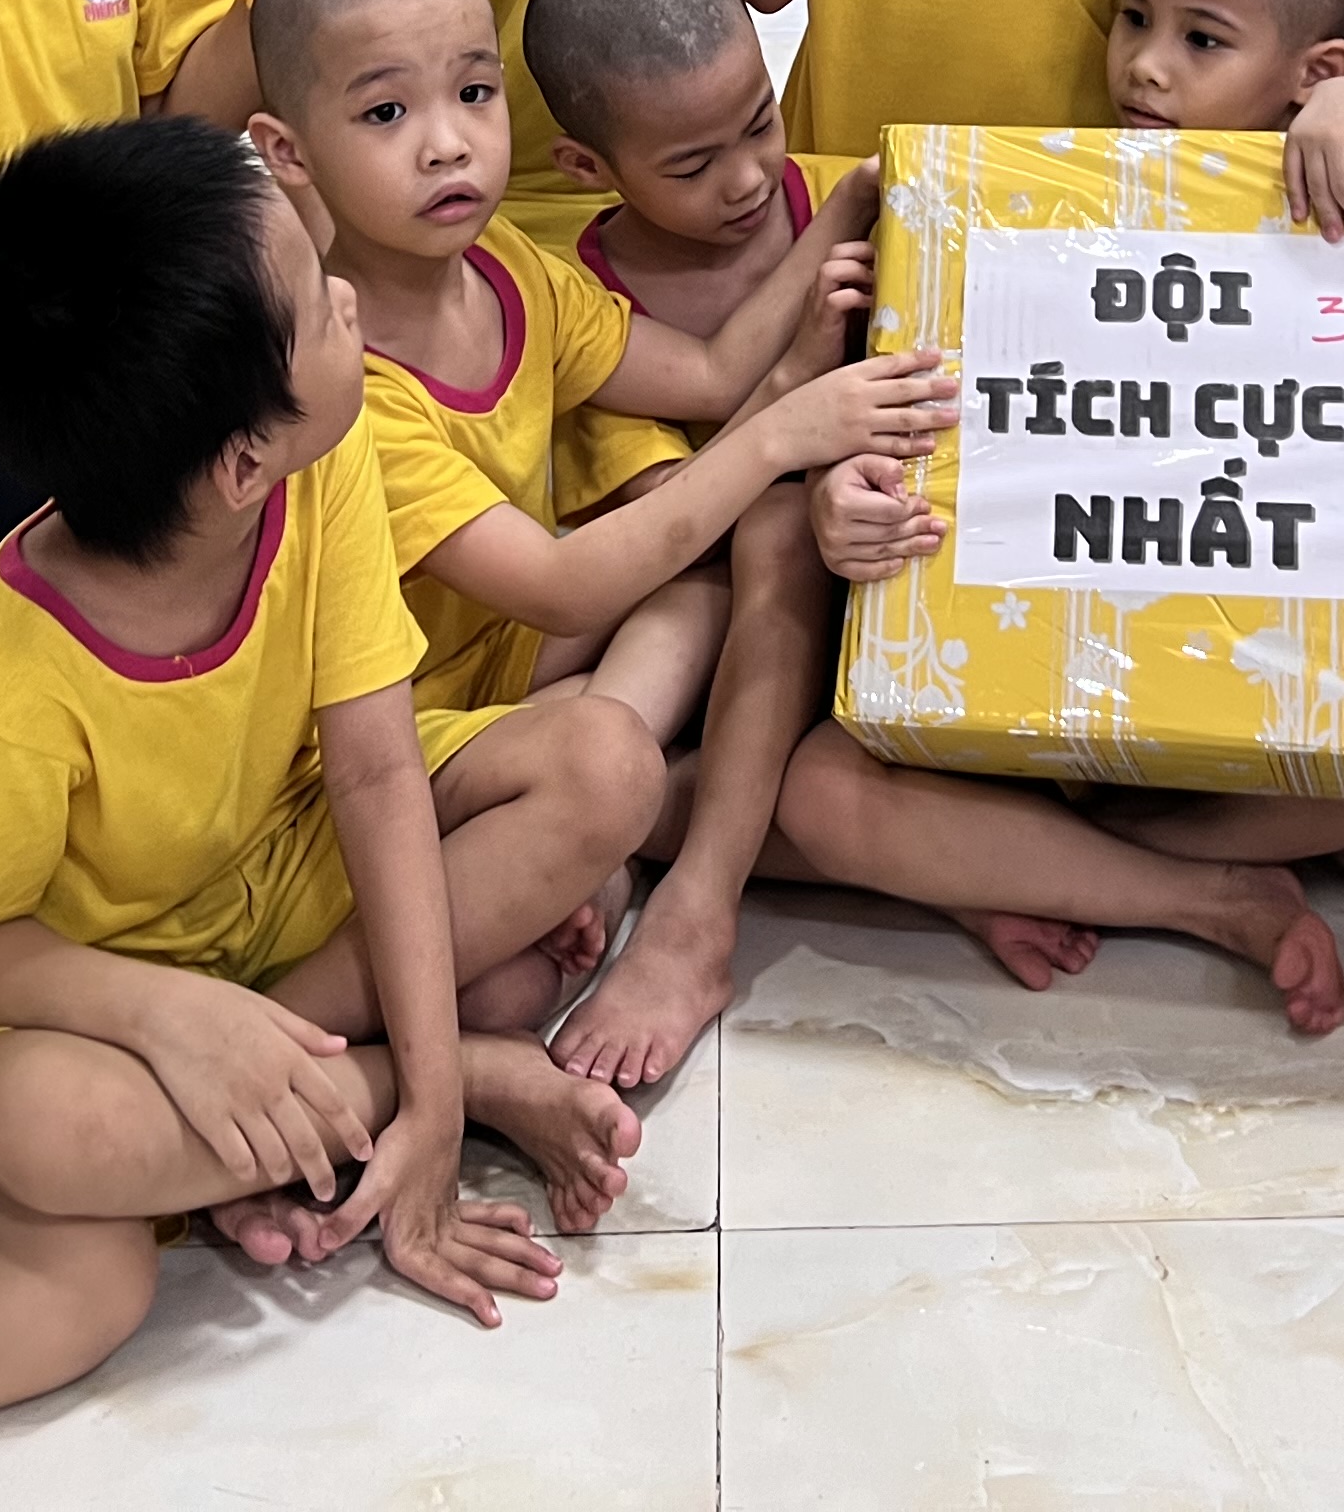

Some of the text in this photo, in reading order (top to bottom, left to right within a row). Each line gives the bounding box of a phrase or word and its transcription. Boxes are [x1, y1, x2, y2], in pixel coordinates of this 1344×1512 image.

[1091, 253, 1251, 342] ĐỘI
[976, 361, 1170, 437] TÍCH
[1053, 457, 1316, 571] NHẤT
